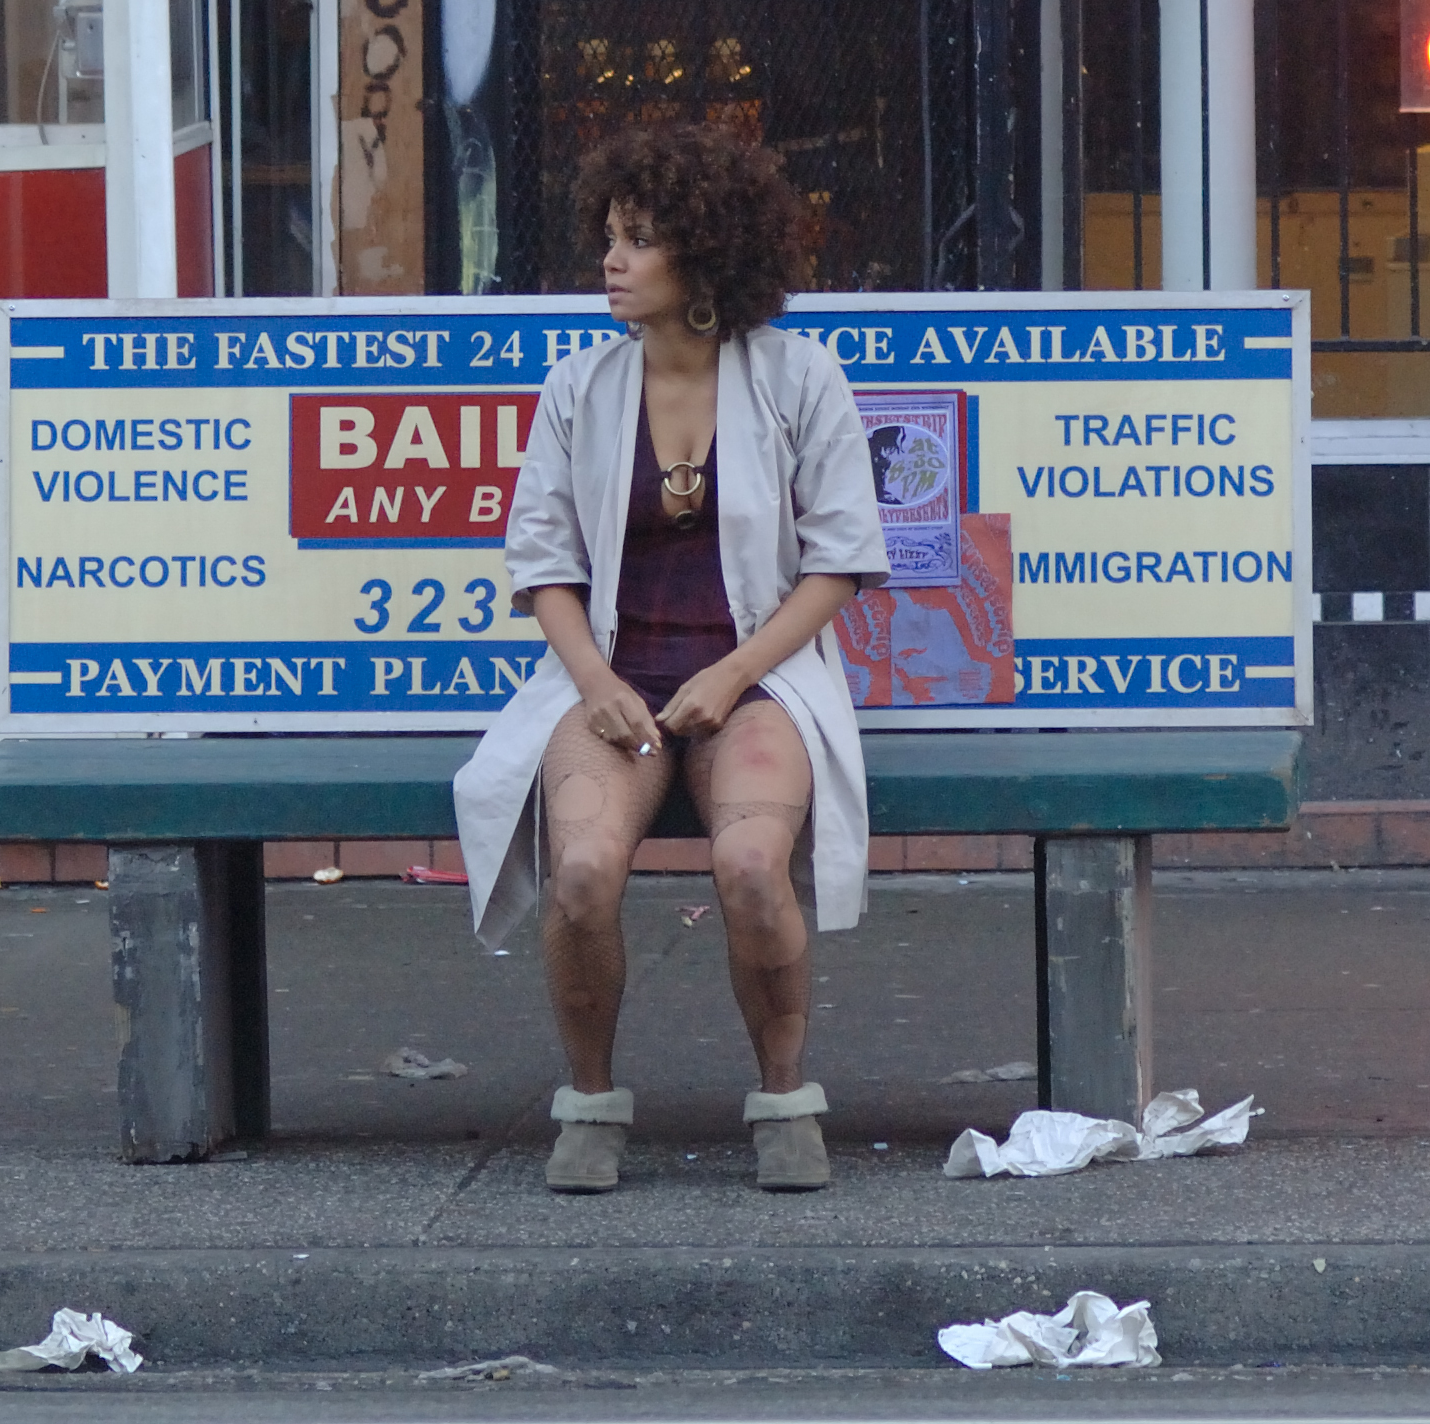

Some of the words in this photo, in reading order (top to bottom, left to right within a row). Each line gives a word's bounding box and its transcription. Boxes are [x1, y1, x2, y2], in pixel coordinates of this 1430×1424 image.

[82, 332, 196, 370] THE
[214, 330, 450, 369] FASTEST
[471, 330, 524, 367] 24
[910, 324, 1226, 364] AVAILABLE
[31, 418, 253, 452] DOMESTIC
[1055, 413, 1237, 446] TRAFFIC
[33, 469, 249, 502] VIOLENCE
[1017, 465, 1275, 498] VIOLATIONS
[325, 486, 448, 523] ANY
[17, 555, 267, 589] NARCOTICS
[1012, 551, 1293, 584] MMIGRATION
[65, 657, 346, 697] PAYMENT
[369, 656, 544, 696] PLAN
